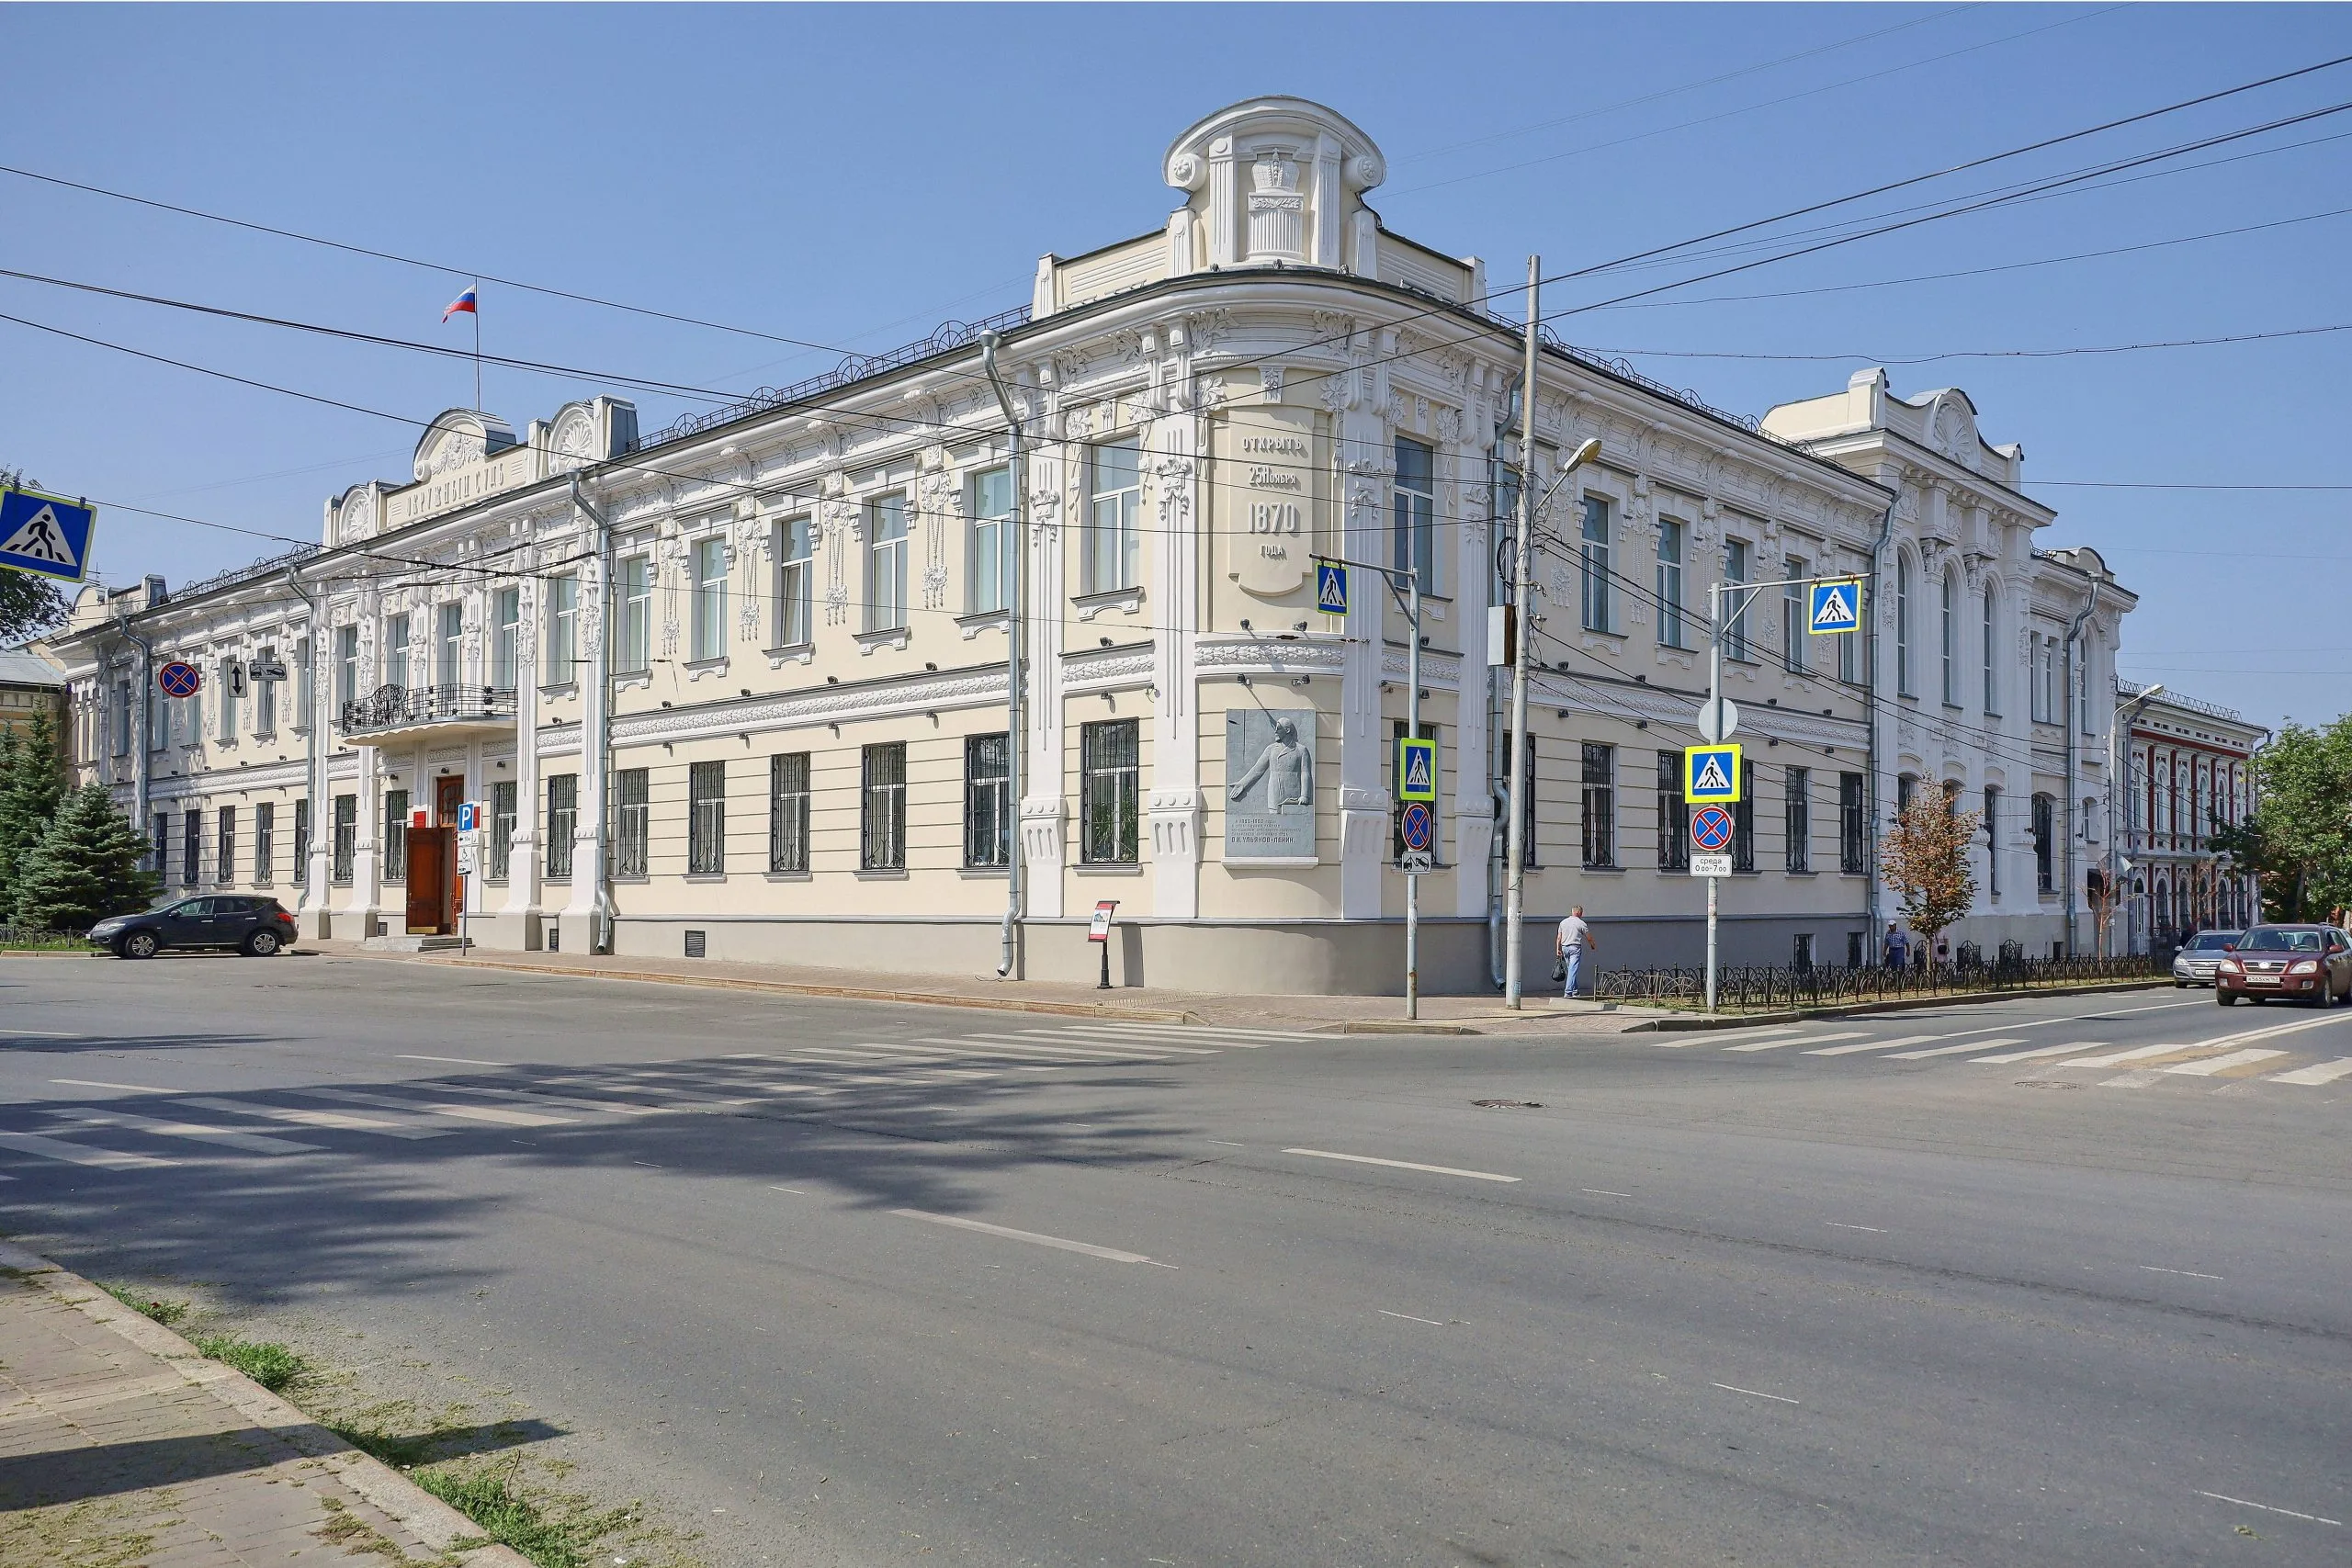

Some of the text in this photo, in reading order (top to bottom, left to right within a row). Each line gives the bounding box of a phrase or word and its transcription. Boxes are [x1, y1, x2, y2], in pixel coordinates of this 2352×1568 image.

[1249, 502, 1295, 533] 1870
[1260, 543, 1284, 557] ГОДА
[461, 807, 470, 829] P
